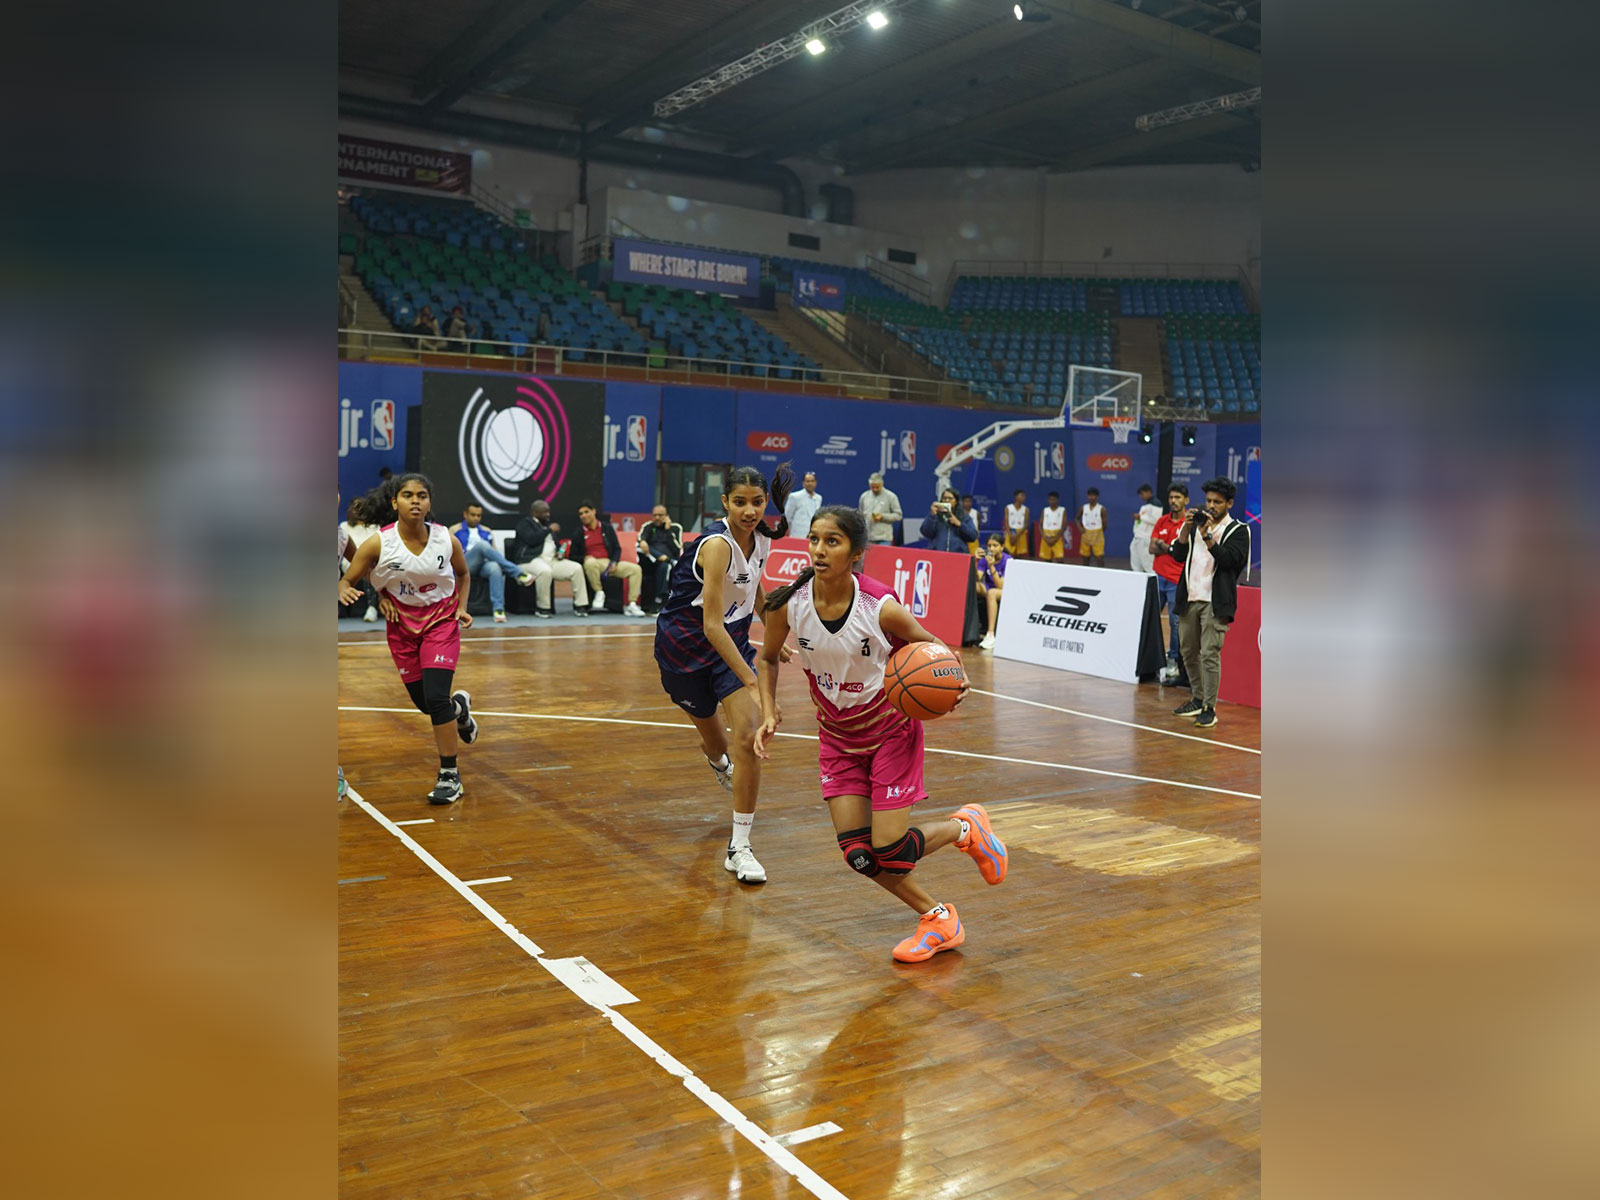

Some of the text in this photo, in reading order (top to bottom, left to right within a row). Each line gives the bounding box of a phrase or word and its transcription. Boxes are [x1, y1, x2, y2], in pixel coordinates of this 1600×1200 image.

[629, 251, 664, 275] WHERE
[664, 256, 697, 279] STARS
[697, 260, 716, 282] ARE
[338, 398, 369, 457] jr.
[762, 436, 789, 448] ACG
[1033, 441, 1052, 485] jr.
[1102, 458, 1129, 469] ACG
[437, 555, 445, 569] 2
[1027, 613, 1108, 635] SKECHERS
[861, 638, 871, 656] 3
[1042, 637, 1059, 650] OFFICIAL
[1066, 640, 1085, 654] PARTNER
